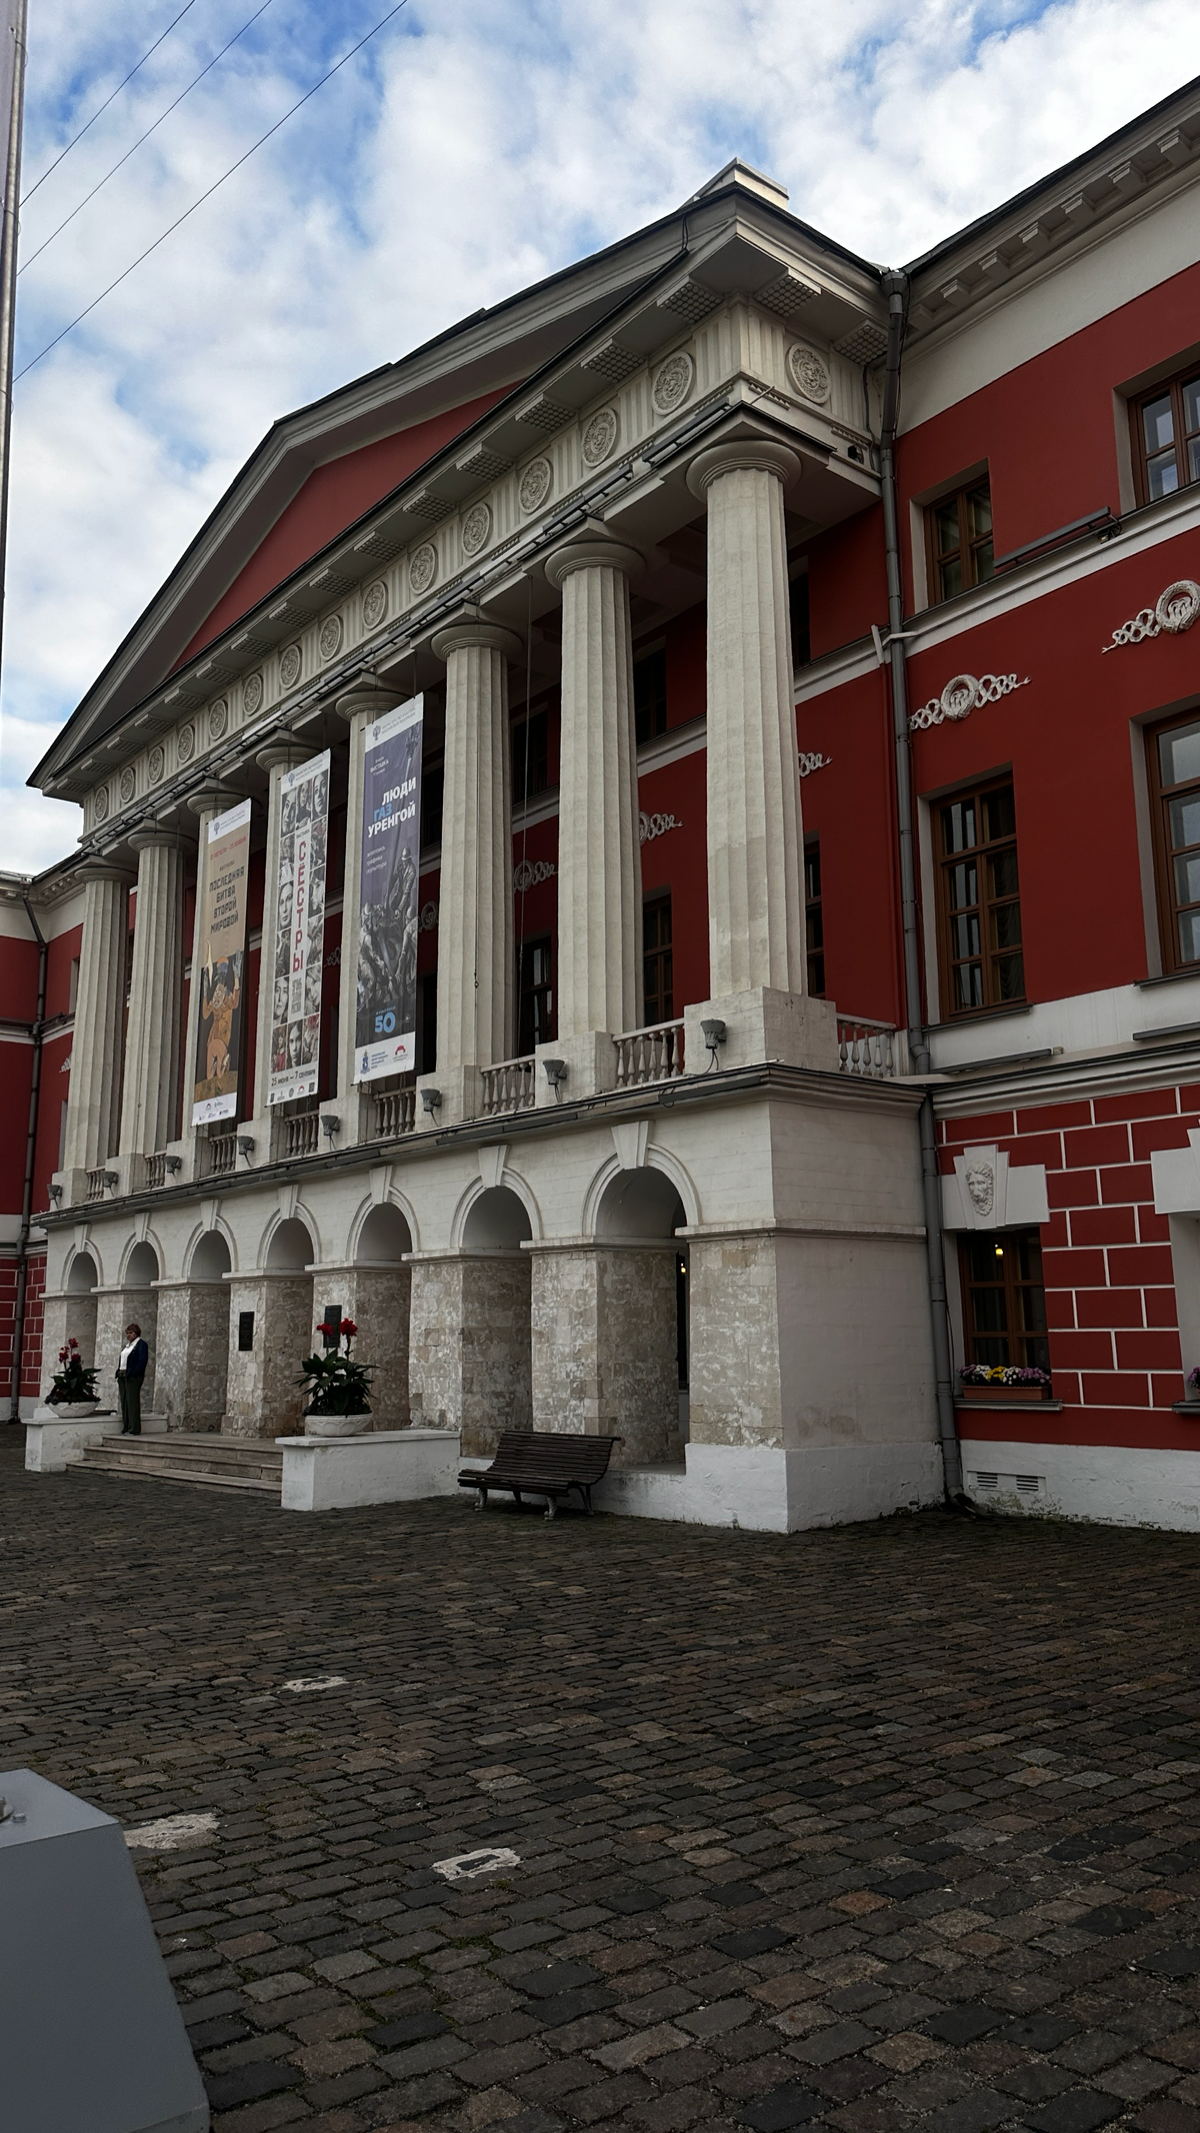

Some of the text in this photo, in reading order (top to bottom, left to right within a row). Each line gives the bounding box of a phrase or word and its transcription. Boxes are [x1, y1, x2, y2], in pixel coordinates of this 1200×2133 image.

[382, 777, 416, 806] ЛЮДИ
[368, 801, 416, 839] УРЕНГОЙ
[374, 803, 392, 823] ГАЗ
[209, 866, 245, 893] ПОСЛЕДНЯЯ
[216, 885, 235, 903] БИТВА
[214, 896, 237, 919] ВТОРОЙ
[210, 910, 239, 934] МИРОВОЙ
[374, 1011, 396, 1033] 50
